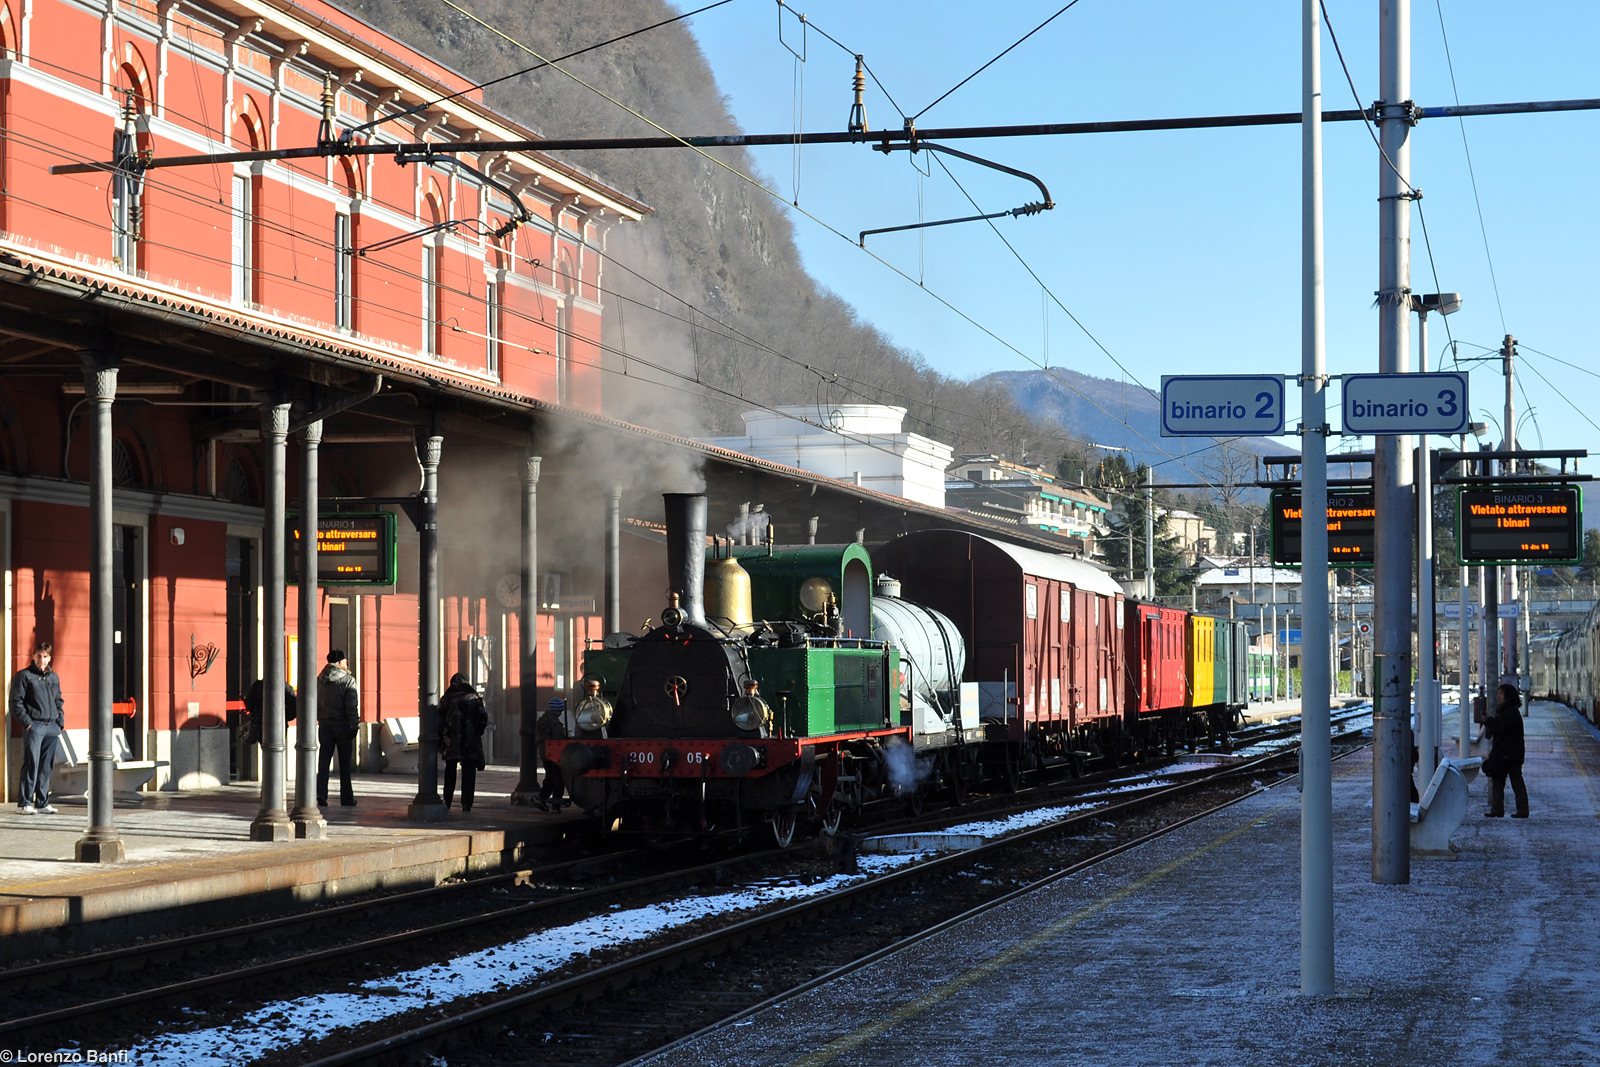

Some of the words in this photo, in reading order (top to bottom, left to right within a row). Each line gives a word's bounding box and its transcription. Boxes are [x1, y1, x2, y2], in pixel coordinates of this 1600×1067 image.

[1171, 401, 1246, 420] binario
[1254, 392, 1274, 419] 2
[1352, 398, 1428, 418] binario
[1436, 389, 1458, 417] 3
[1348, 498, 1354, 506] 2
[1494, 494, 1534, 504] BINARIO
[1537, 494, 1544, 503] 3
[1282, 508, 1302, 519] Viet
[1326, 507, 1376, 517] ttraversare
[1470, 504, 1506, 515] Vietato
[1507, 504, 1568, 514] attraversare
[1502, 517, 1530, 528] binari
[326, 529, 377, 539] attraversare
[322, 542, 346, 552] binari
[629, 752, 655, 763] 200
[686, 752, 702, 764] 05
